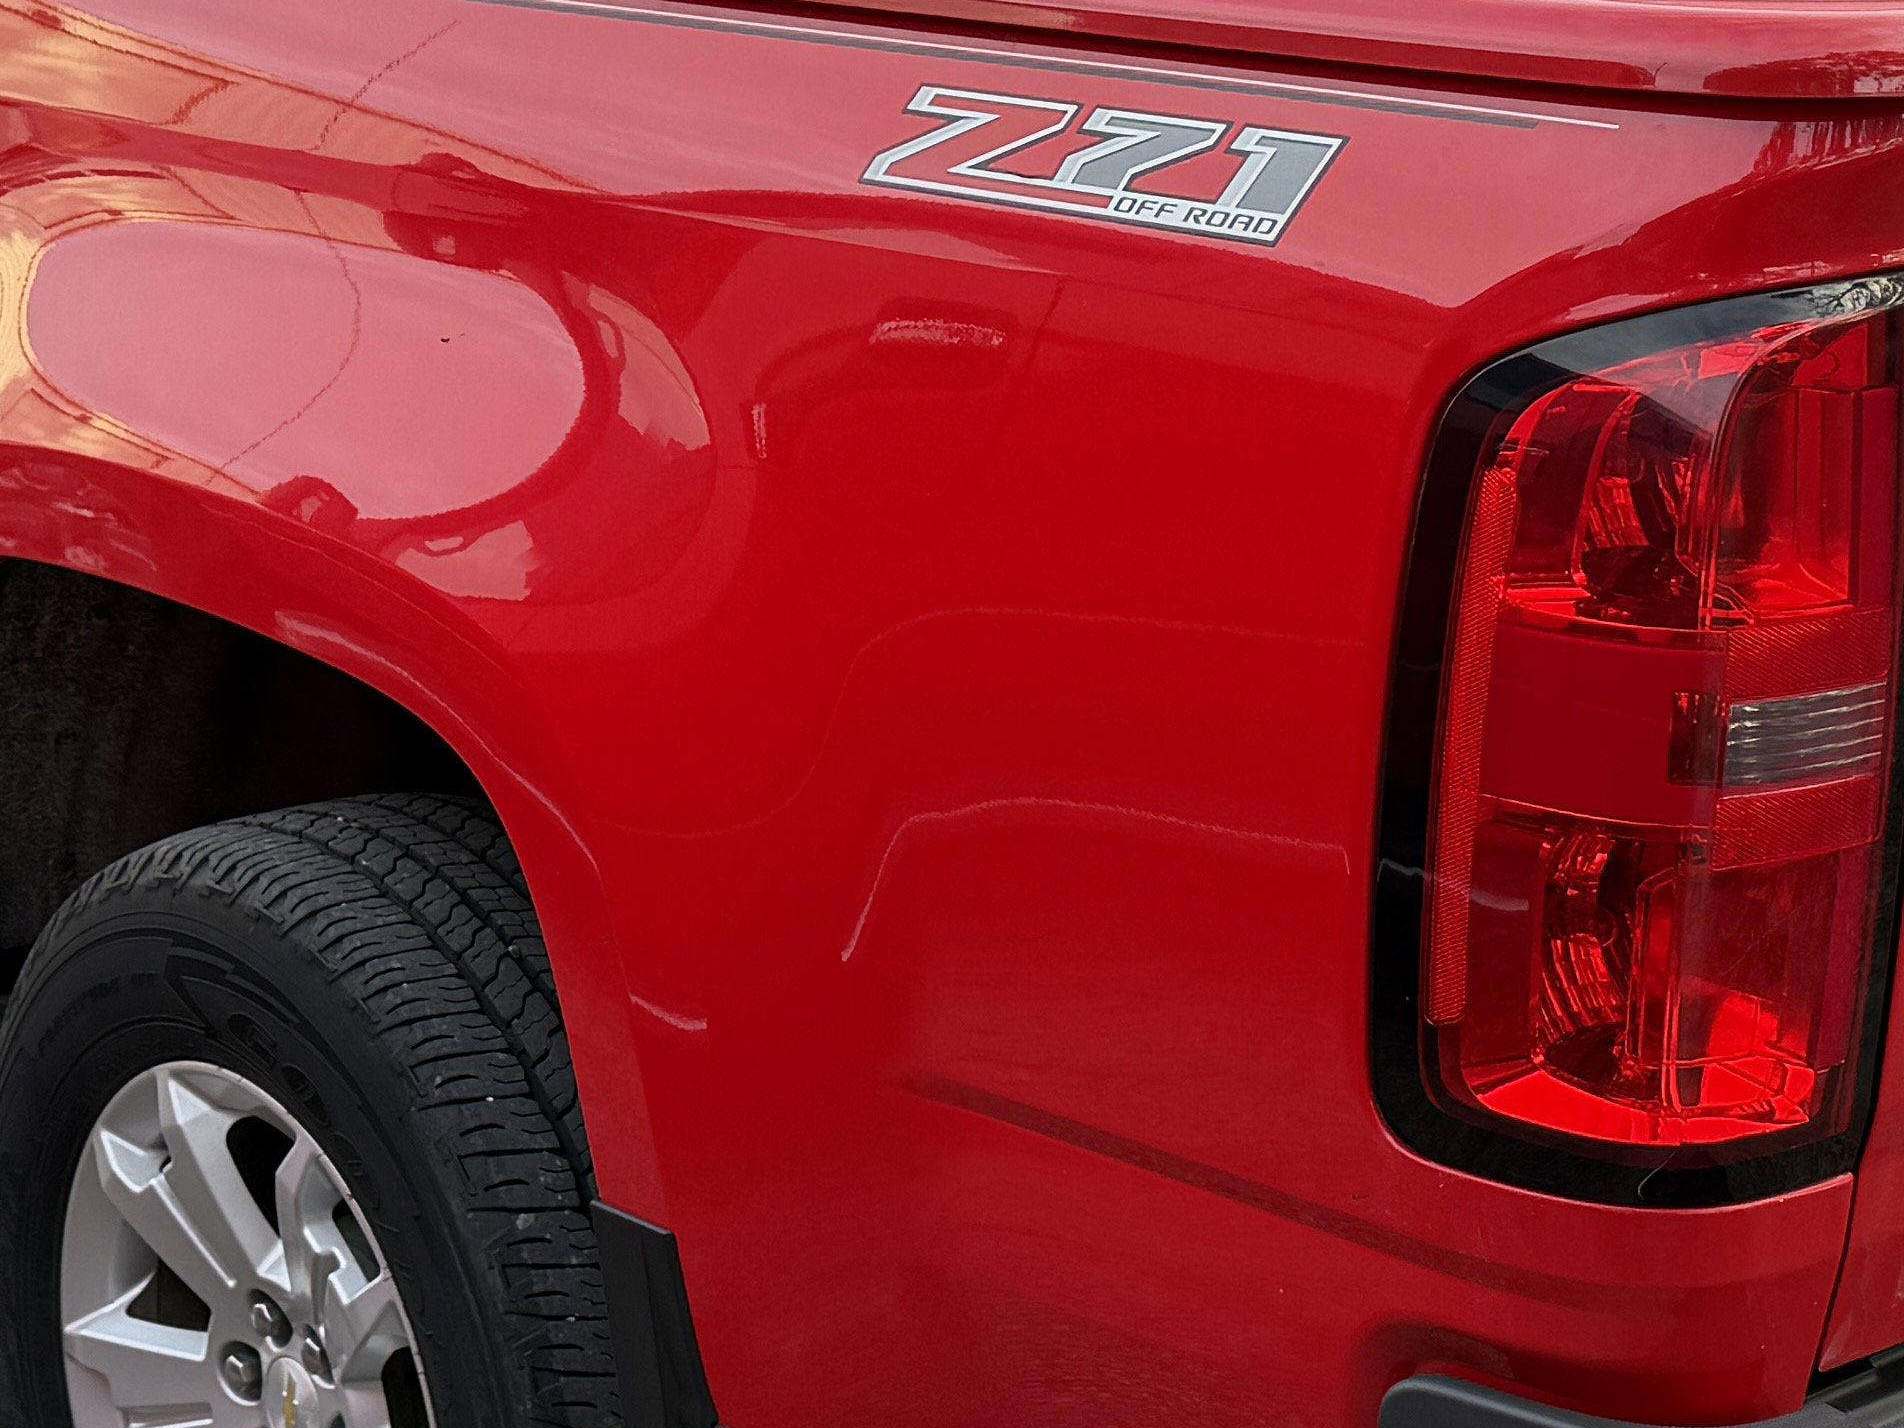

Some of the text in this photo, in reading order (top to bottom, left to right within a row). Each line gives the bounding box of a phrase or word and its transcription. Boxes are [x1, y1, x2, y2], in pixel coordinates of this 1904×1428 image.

[858, 84, 1351, 214] Z71
[1111, 195, 1278, 236] OFF ROAD
